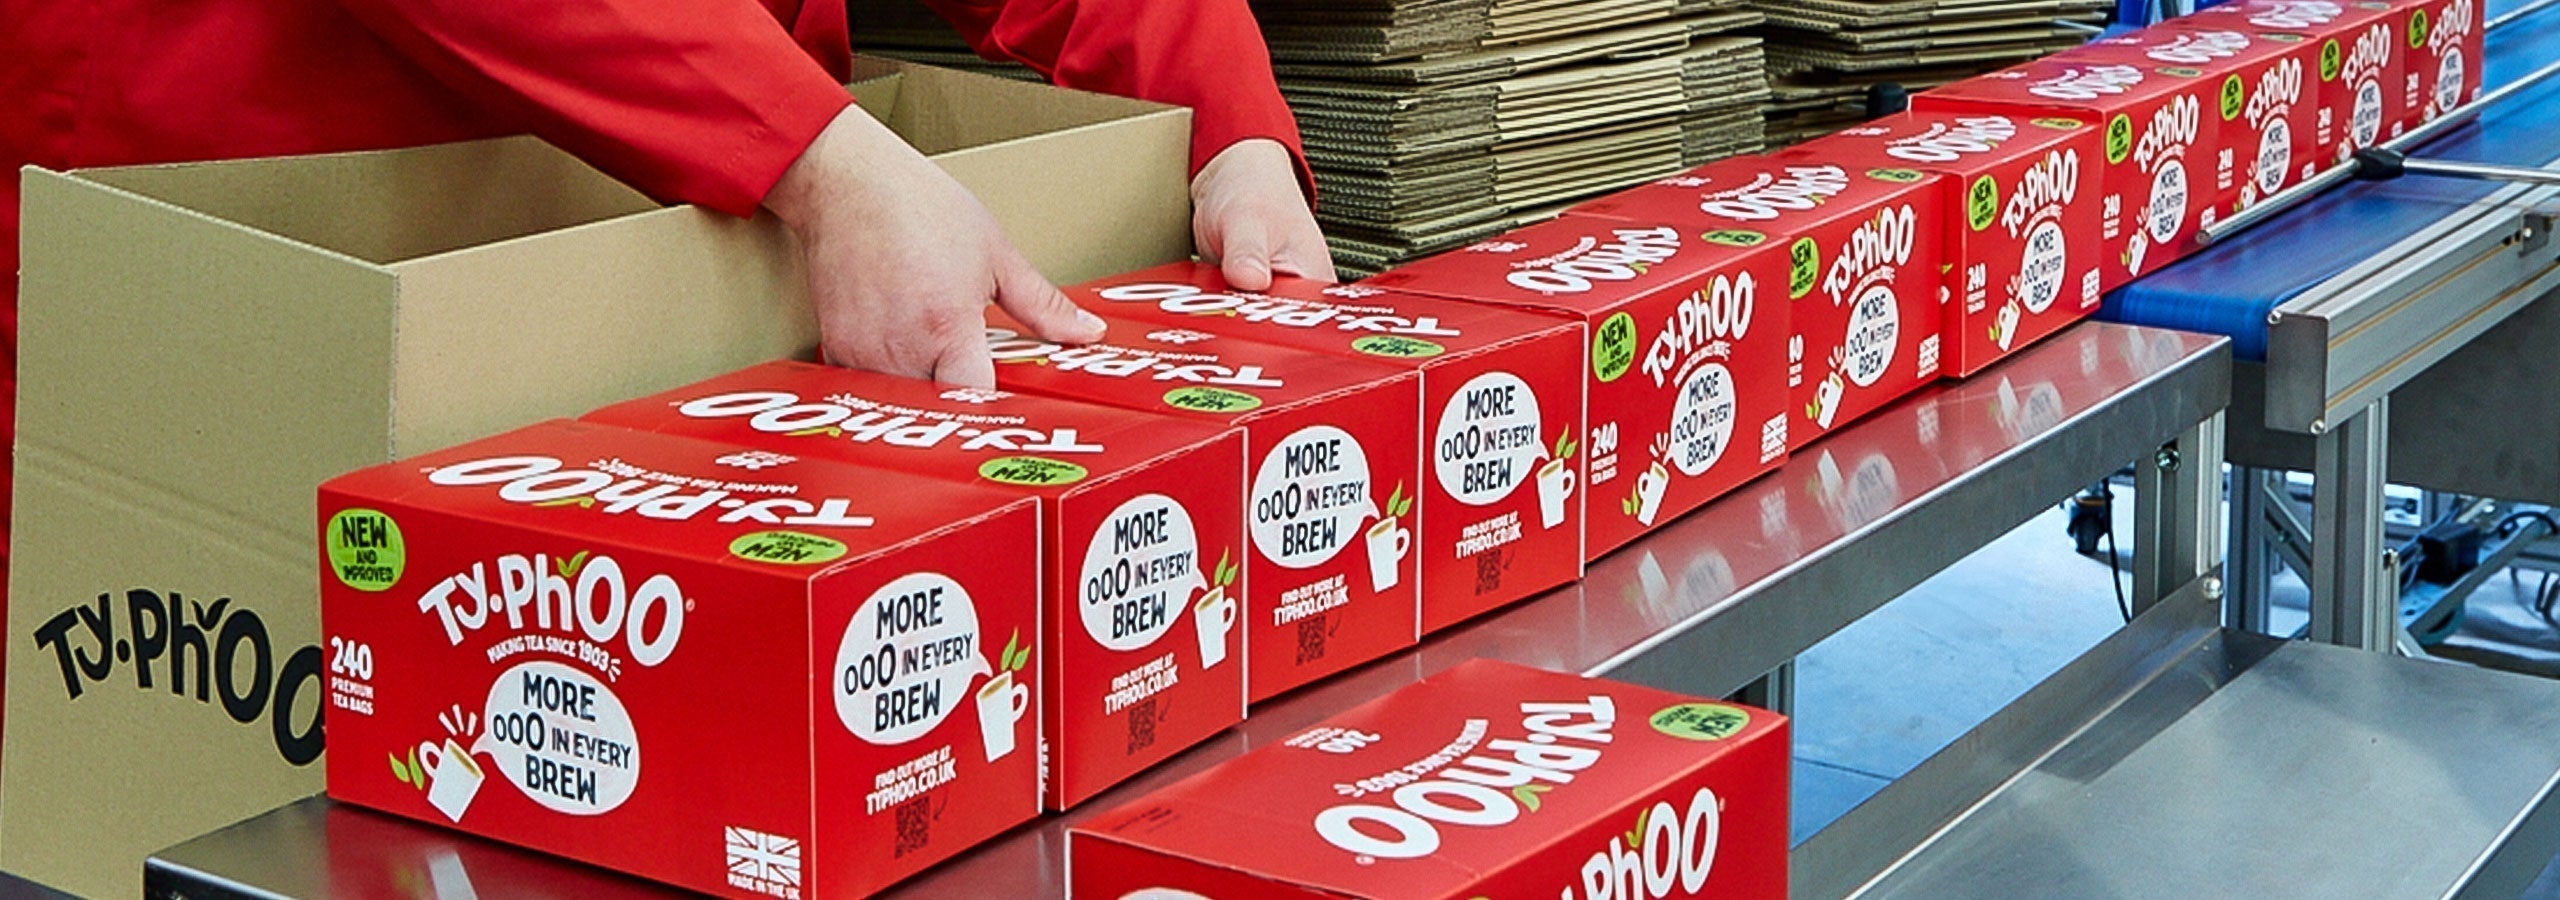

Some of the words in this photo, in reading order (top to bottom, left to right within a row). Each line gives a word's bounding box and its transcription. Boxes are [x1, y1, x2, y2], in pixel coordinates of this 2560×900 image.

[1967, 262, 1986, 292] 240
[1601, 314, 1629, 349] NEW
[1465, 385, 1516, 421] MORE
[1688, 371, 1720, 407] MORE
[1484, 428, 1498, 452] IN
[1591, 421, 1618, 458] 240
[1285, 439, 1341, 479] MORE
[1463, 456, 1512, 494] BREW
[1305, 486, 1320, 511] IN
[1321, 480, 1365, 509] EVERY
[341, 516, 388, 548] NEW
[1114, 507, 1169, 555] MORE
[1282, 516, 1337, 557] BREW
[356, 550, 377, 564] AND
[1135, 561, 1149, 588] IN
[1150, 551, 1192, 584] EVERY
[876, 586, 944, 640] MORE
[1112, 591, 1167, 640] BREW
[331, 635, 374, 681] 240
[487, 636, 525, 664] MAKING
[524, 635, 546, 650] TEA
[545, 636, 576, 657] SINCE
[578, 640, 610, 671] 1903
[902, 647, 919, 676] IN
[921, 632, 973, 671] EVERY
[332, 692, 349, 709] TEA
[523, 671, 596, 722] MORE
[874, 678, 941, 733] BREW
[552, 727, 569, 755] IN
[573, 733, 632, 770] EVERY
[525, 754, 596, 806] BREW
[866, 758, 957, 816] TYPHOO.CO.UK
